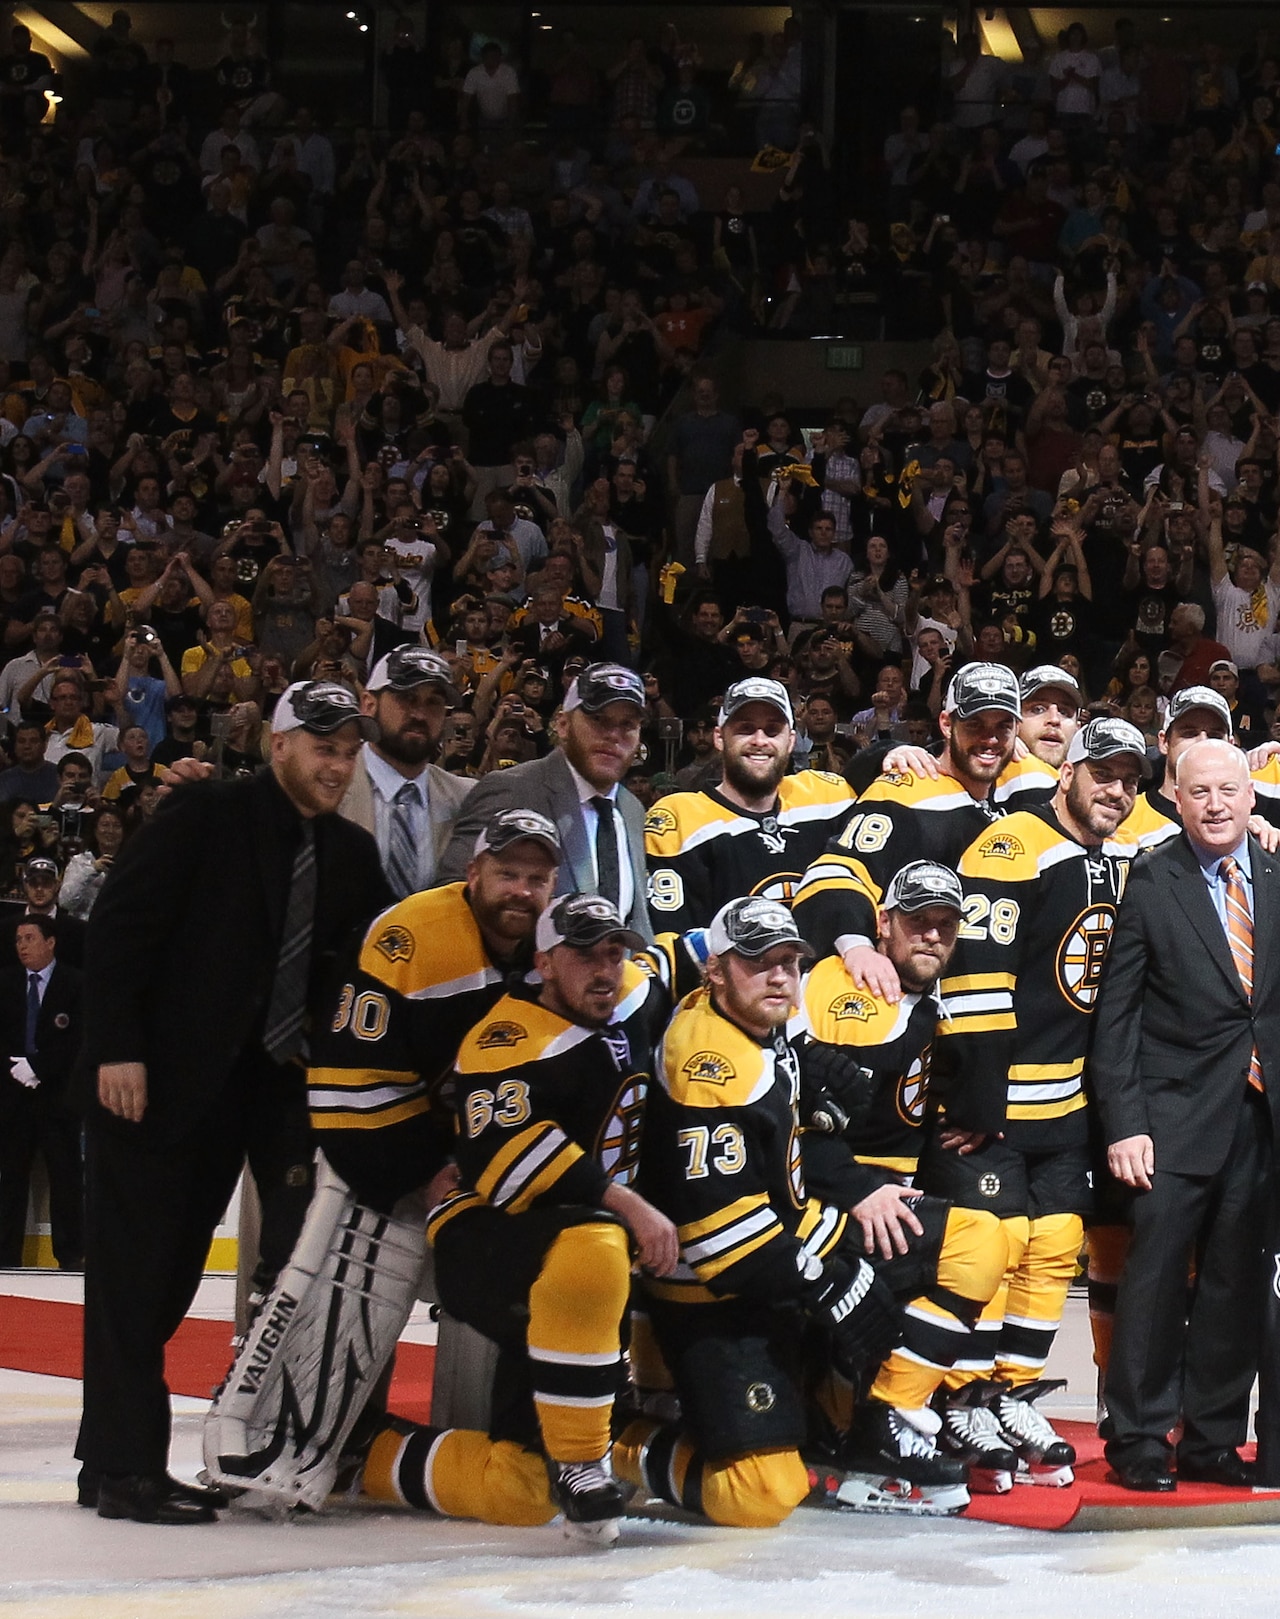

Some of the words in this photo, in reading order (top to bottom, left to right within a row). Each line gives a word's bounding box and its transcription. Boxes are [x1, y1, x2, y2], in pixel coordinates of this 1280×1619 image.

[837, 812, 893, 853] 18
[647, 868, 685, 911] 9
[957, 894, 1020, 945] 28
[1081, 929, 1113, 989] B
[465, 1080, 532, 1138] 63
[677, 1122, 747, 1180] 73
[237, 1291, 299, 1394] VAUGHN
